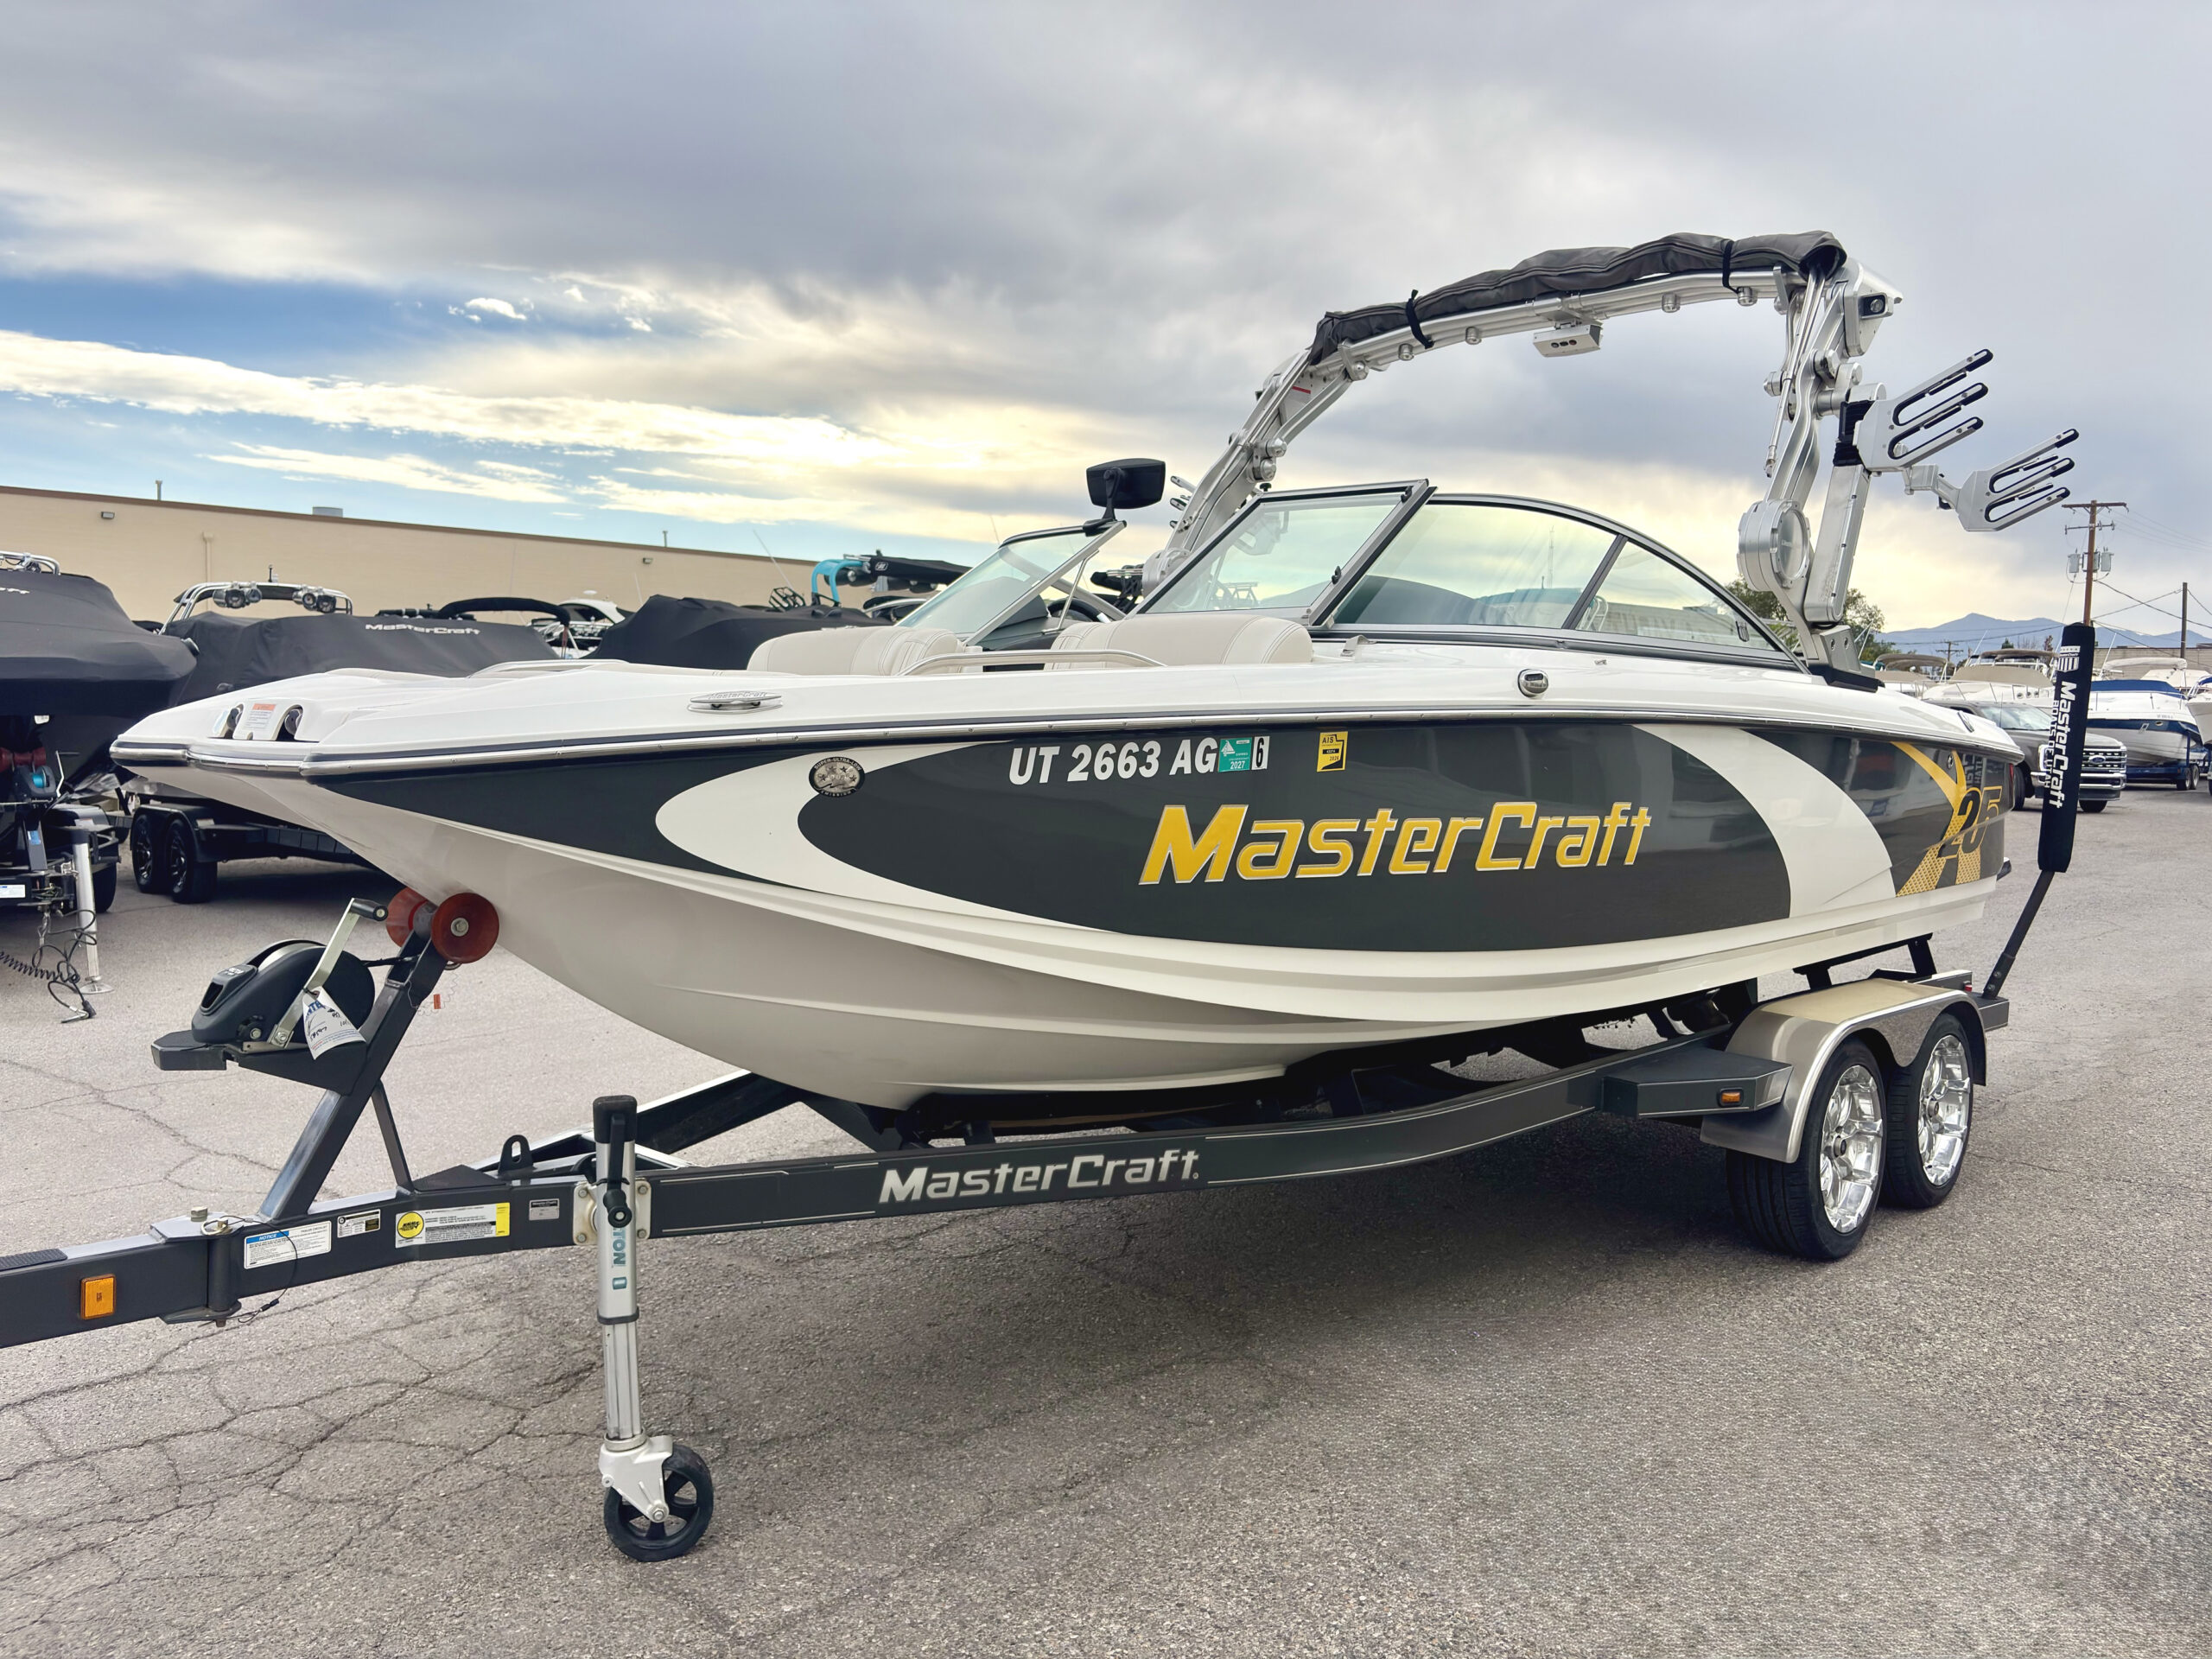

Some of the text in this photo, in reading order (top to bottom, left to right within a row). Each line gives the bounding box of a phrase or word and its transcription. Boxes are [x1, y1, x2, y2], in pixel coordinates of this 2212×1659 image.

[1009, 737, 1218, 785] UT 2663 AG
[1230, 760, 1246, 770] 2027
[1255, 737, 1265, 768] 6
[2049, 680, 2077, 810] MasterCraft
[1138, 801, 1652, 886] MasterCraft
[878, 1149, 1200, 1205] MasterCraft
[259, 1233, 277, 1242] NOTICE
[613, 1227, 626, 1266] TON
